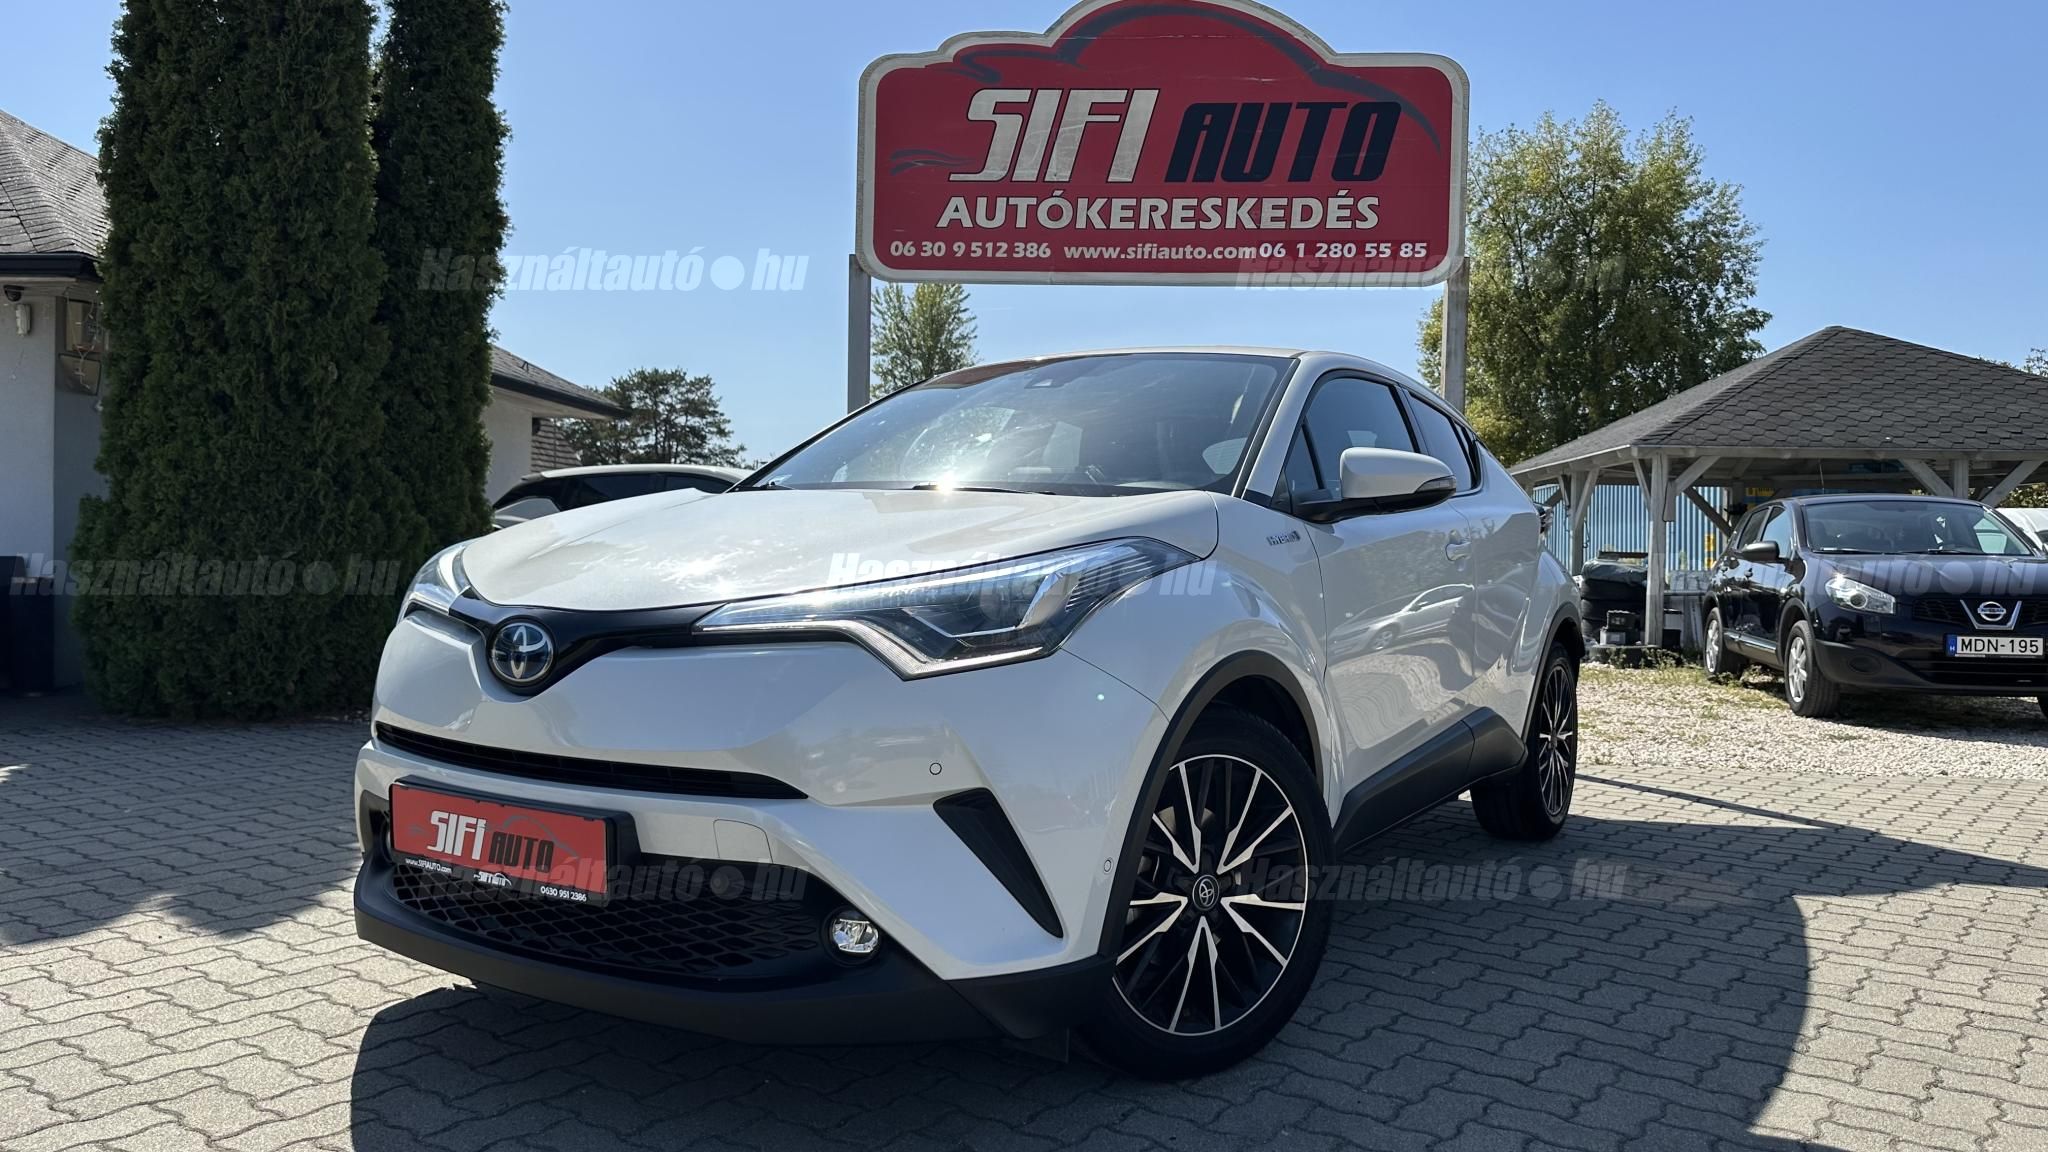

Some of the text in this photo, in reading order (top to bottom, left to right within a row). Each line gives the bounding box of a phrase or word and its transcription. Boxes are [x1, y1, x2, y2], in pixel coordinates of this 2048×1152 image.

[948, 88, 1402, 183] SIFI AUTO
[936, 190, 1380, 231] AUTÓKERESKEDÉS
[890, 241, 1428, 260] 06 30 9 512 386 www.sifiauto.com 06 1 280 55 85
[1961, 638, 2039, 653] MDN-195
[488, 831, 554, 874] AUTO
